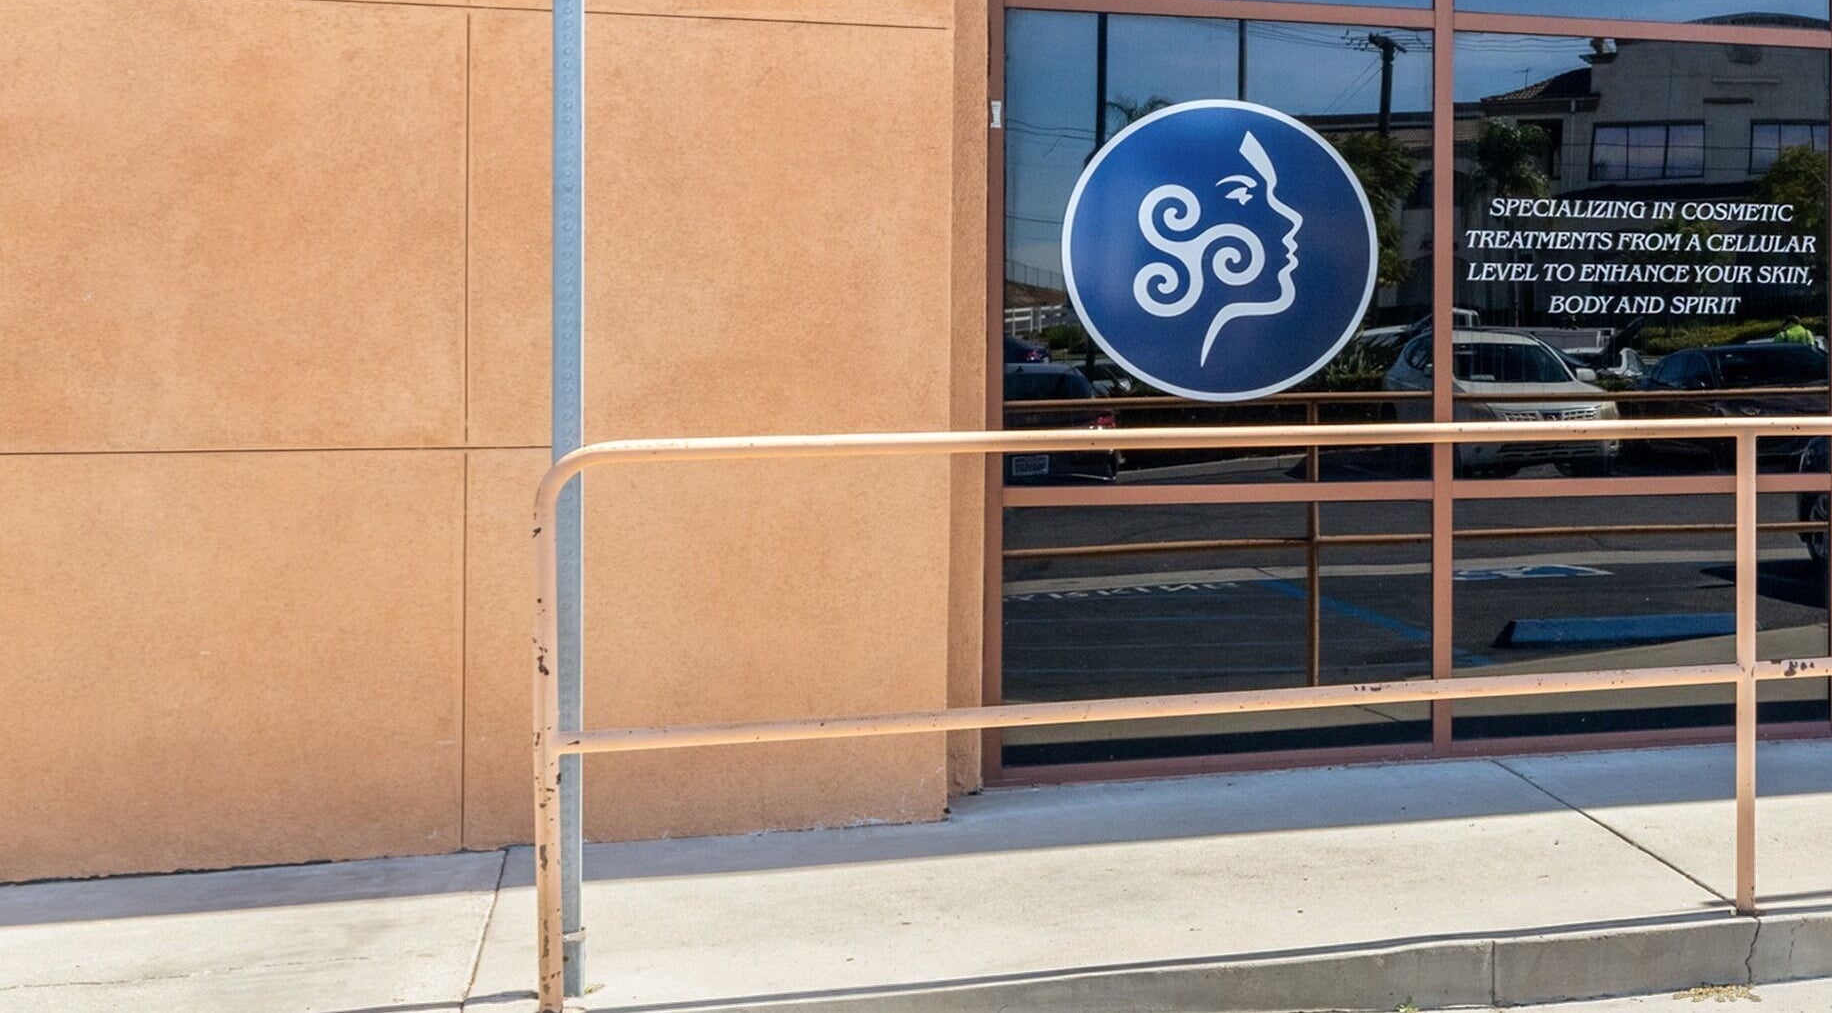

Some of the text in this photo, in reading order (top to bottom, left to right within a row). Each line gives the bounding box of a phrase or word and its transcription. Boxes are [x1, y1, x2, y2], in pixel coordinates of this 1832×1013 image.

[1489, 198, 1794, 222] SPECIALIZING IN COSMETIC
[1465, 230, 1817, 254] TREATMENTS FROM A CELLULAR
[1466, 263, 1815, 287] LEVEL TO ENHANCE YOUR SKIN,
[1548, 295, 1742, 315] BODY AND SPIRIT
